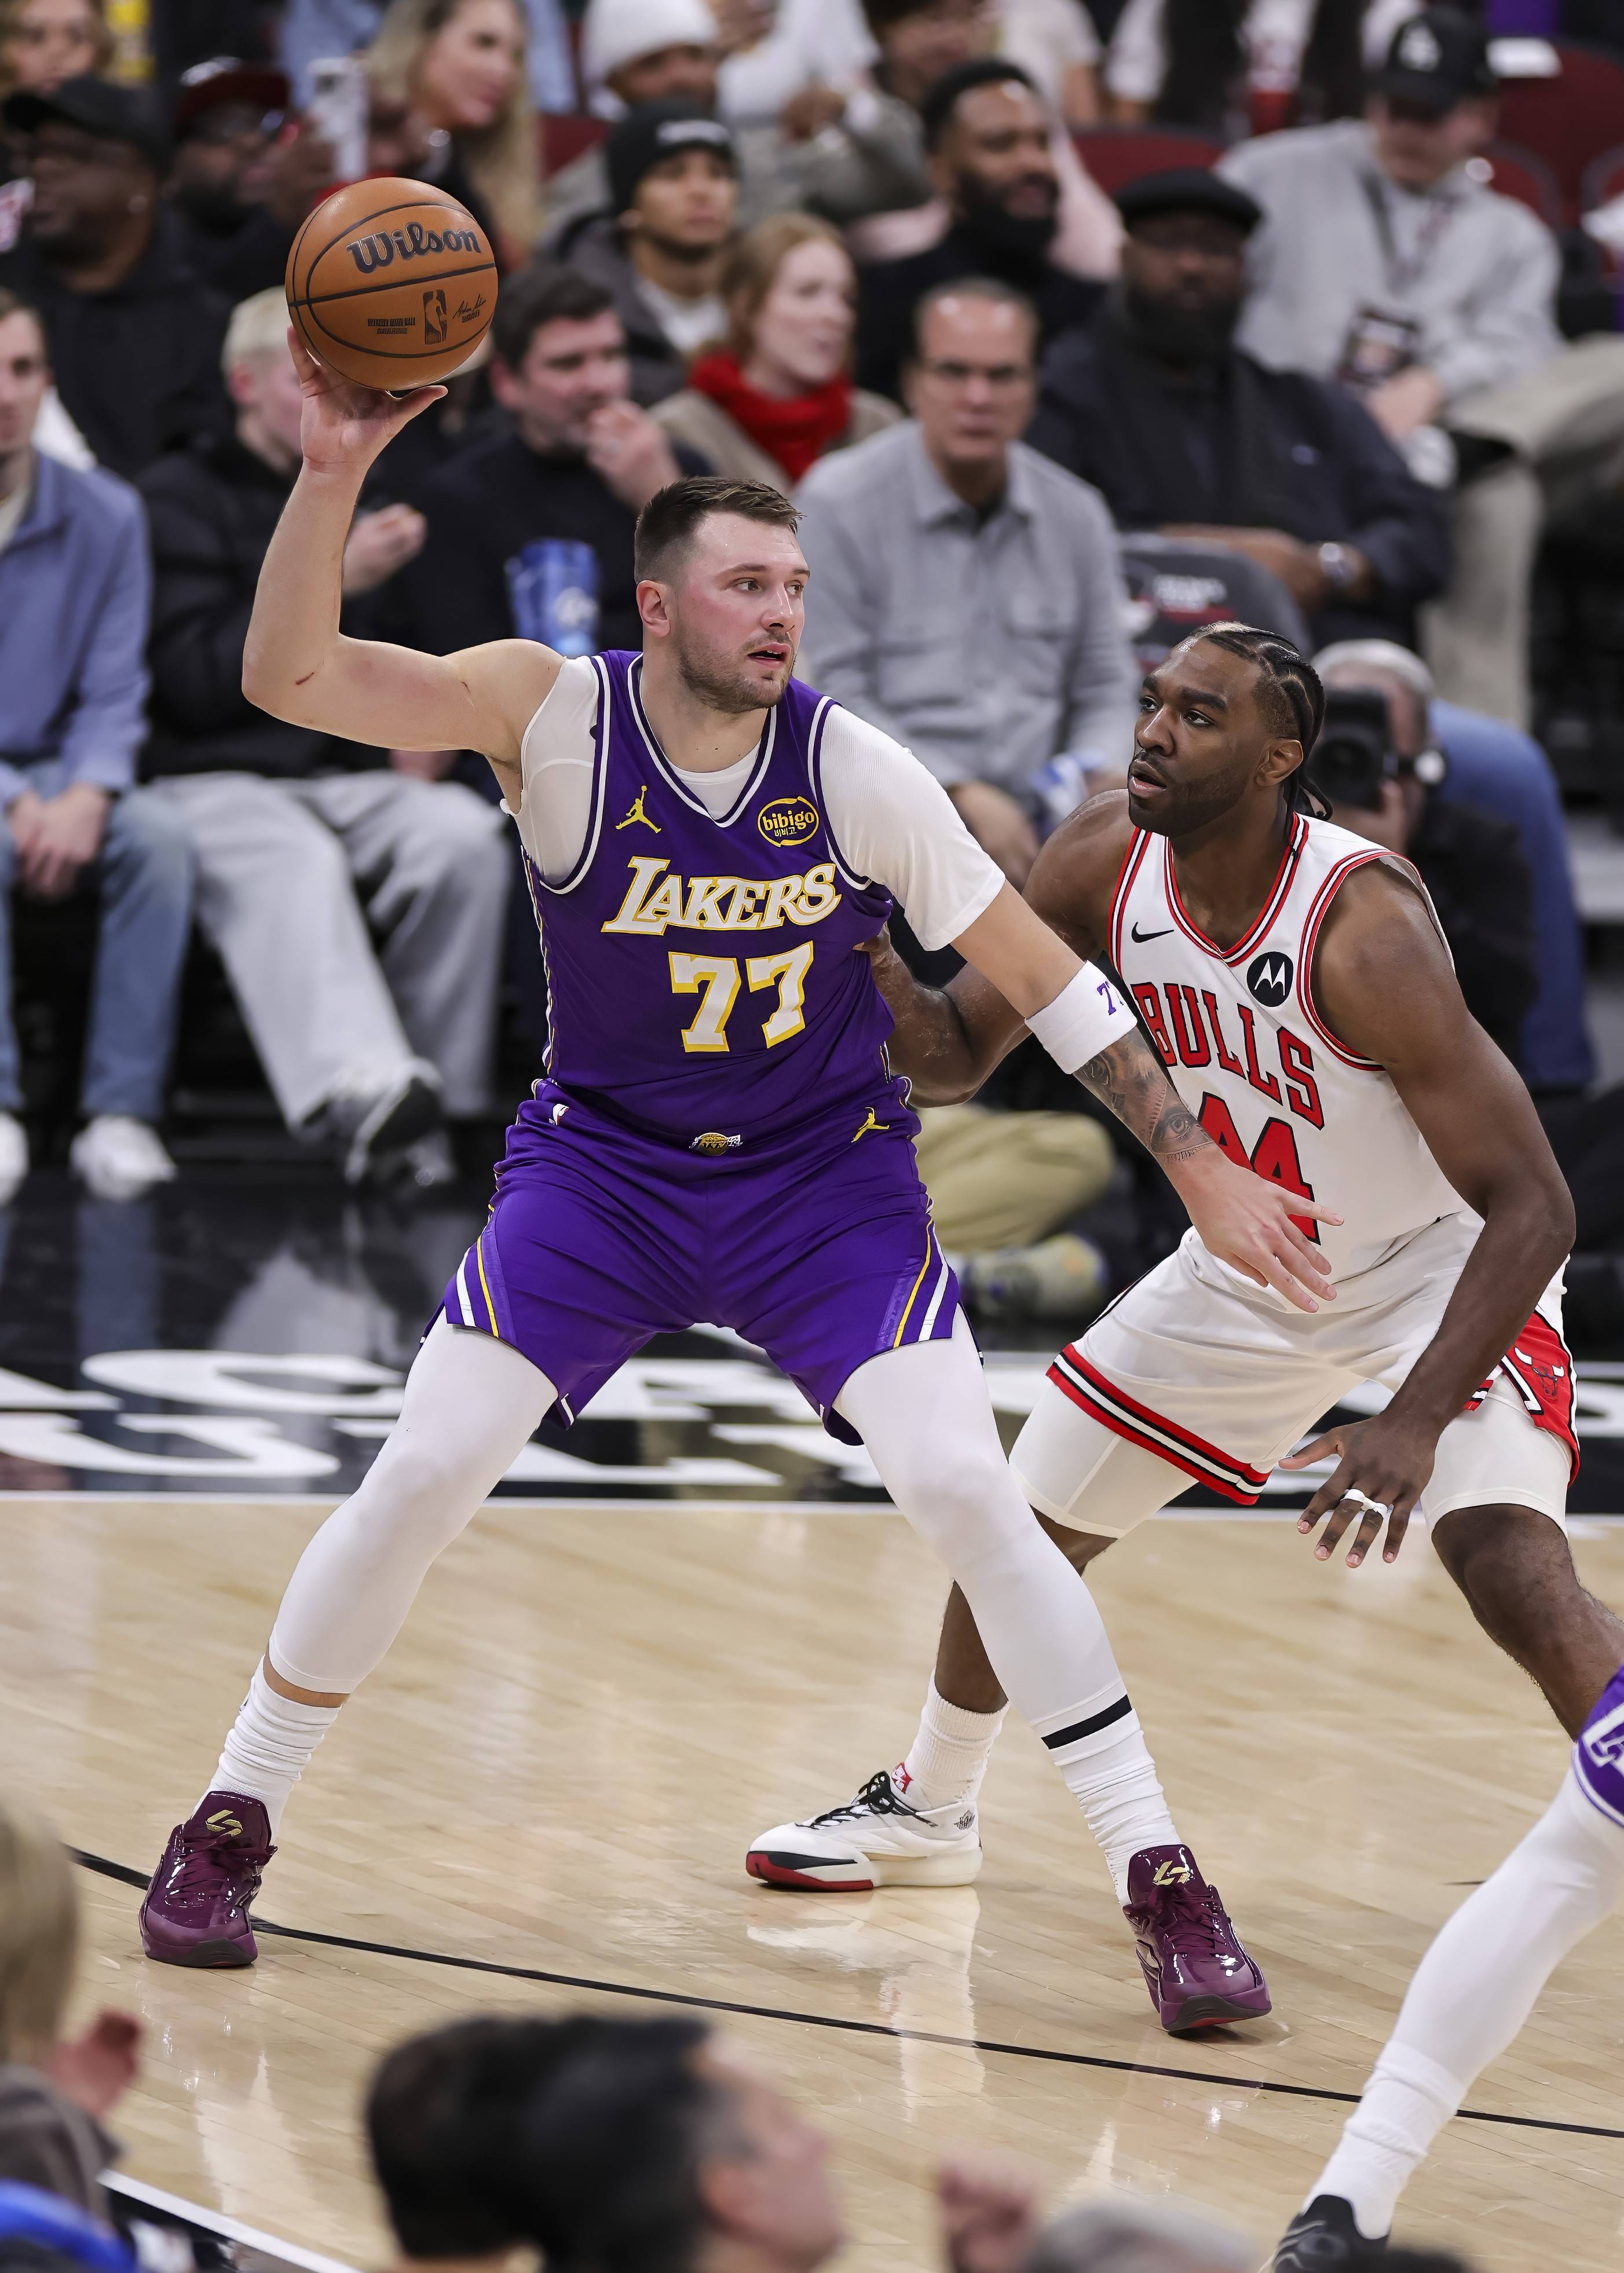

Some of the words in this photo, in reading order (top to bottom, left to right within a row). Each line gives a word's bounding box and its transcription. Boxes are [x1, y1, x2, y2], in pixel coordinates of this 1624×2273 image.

[346, 222, 482, 274] Wilson
[762, 810, 814, 830] bibigo
[601, 856, 842, 935] LAKERS
[668, 940, 814, 1052] 77
[1131, 982, 1325, 1130] BULLS
